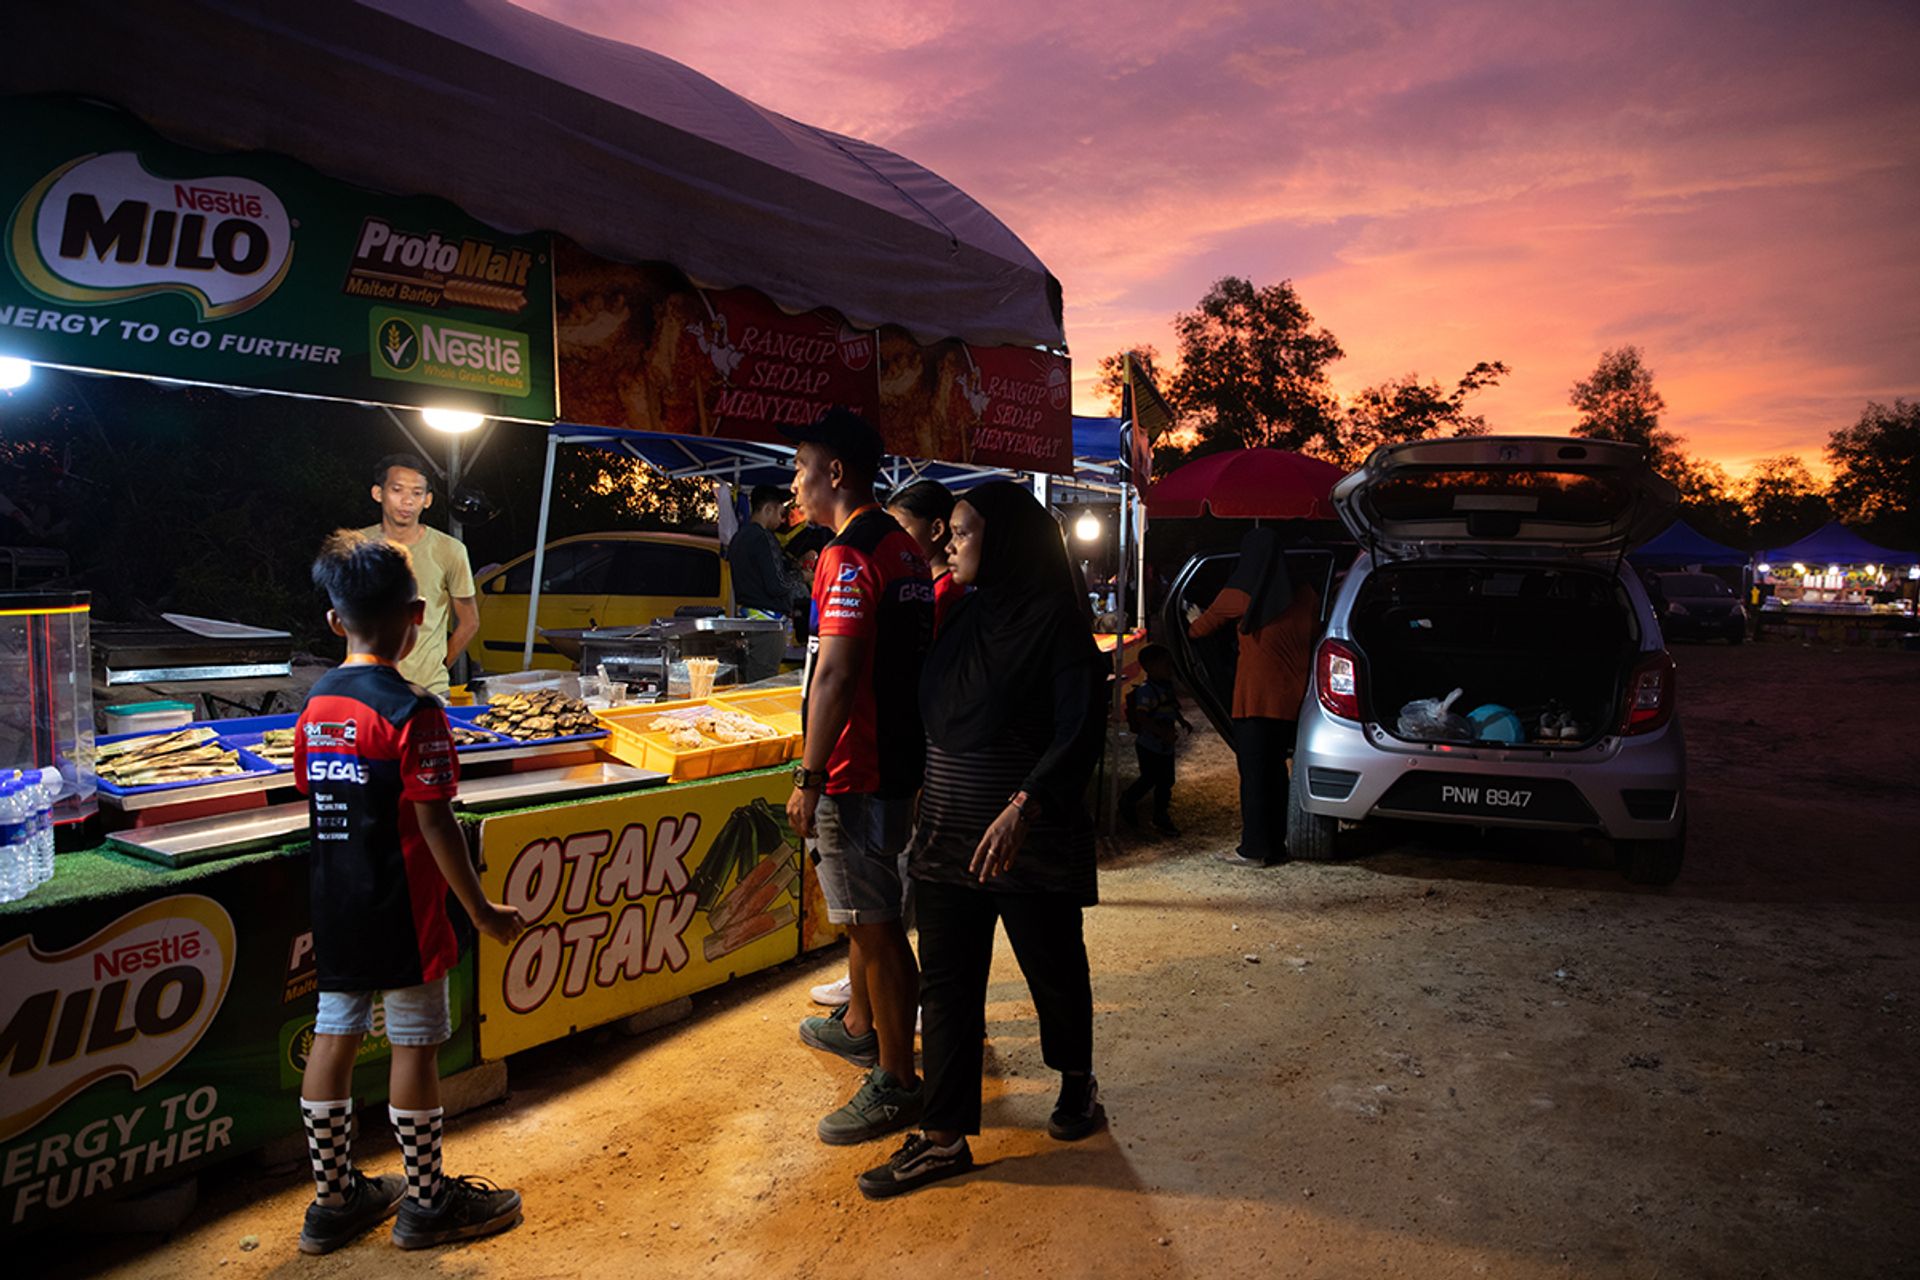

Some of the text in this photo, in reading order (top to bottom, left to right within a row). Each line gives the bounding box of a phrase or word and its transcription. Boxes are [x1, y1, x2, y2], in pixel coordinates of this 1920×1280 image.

[59, 193, 270, 275] MILO
[346, 278, 442, 307] Malted Barley
[119, 320, 161, 343] TO
[167, 327, 213, 350] GO
[218, 333, 342, 365] FURTHER
[737, 326, 837, 365] RANGUP
[423, 363, 524, 389] Whole Grain Cereals
[749, 360, 831, 395] SEDAP
[987, 376, 1048, 407] RANGUP
[712, 390, 864, 426] MENYENG
[992, 403, 1043, 430] SEDAP
[971, 427, 1063, 460] MENYENGAT
[307, 760, 369, 785] SGAS
[1441, 785, 1532, 807] PNW 8947
[502, 812, 701, 928] OTAK
[502, 891, 698, 1014] OTAK
[2, 1085, 219, 1188] ERGY TO
[11, 1115, 235, 1225] FURTHER
